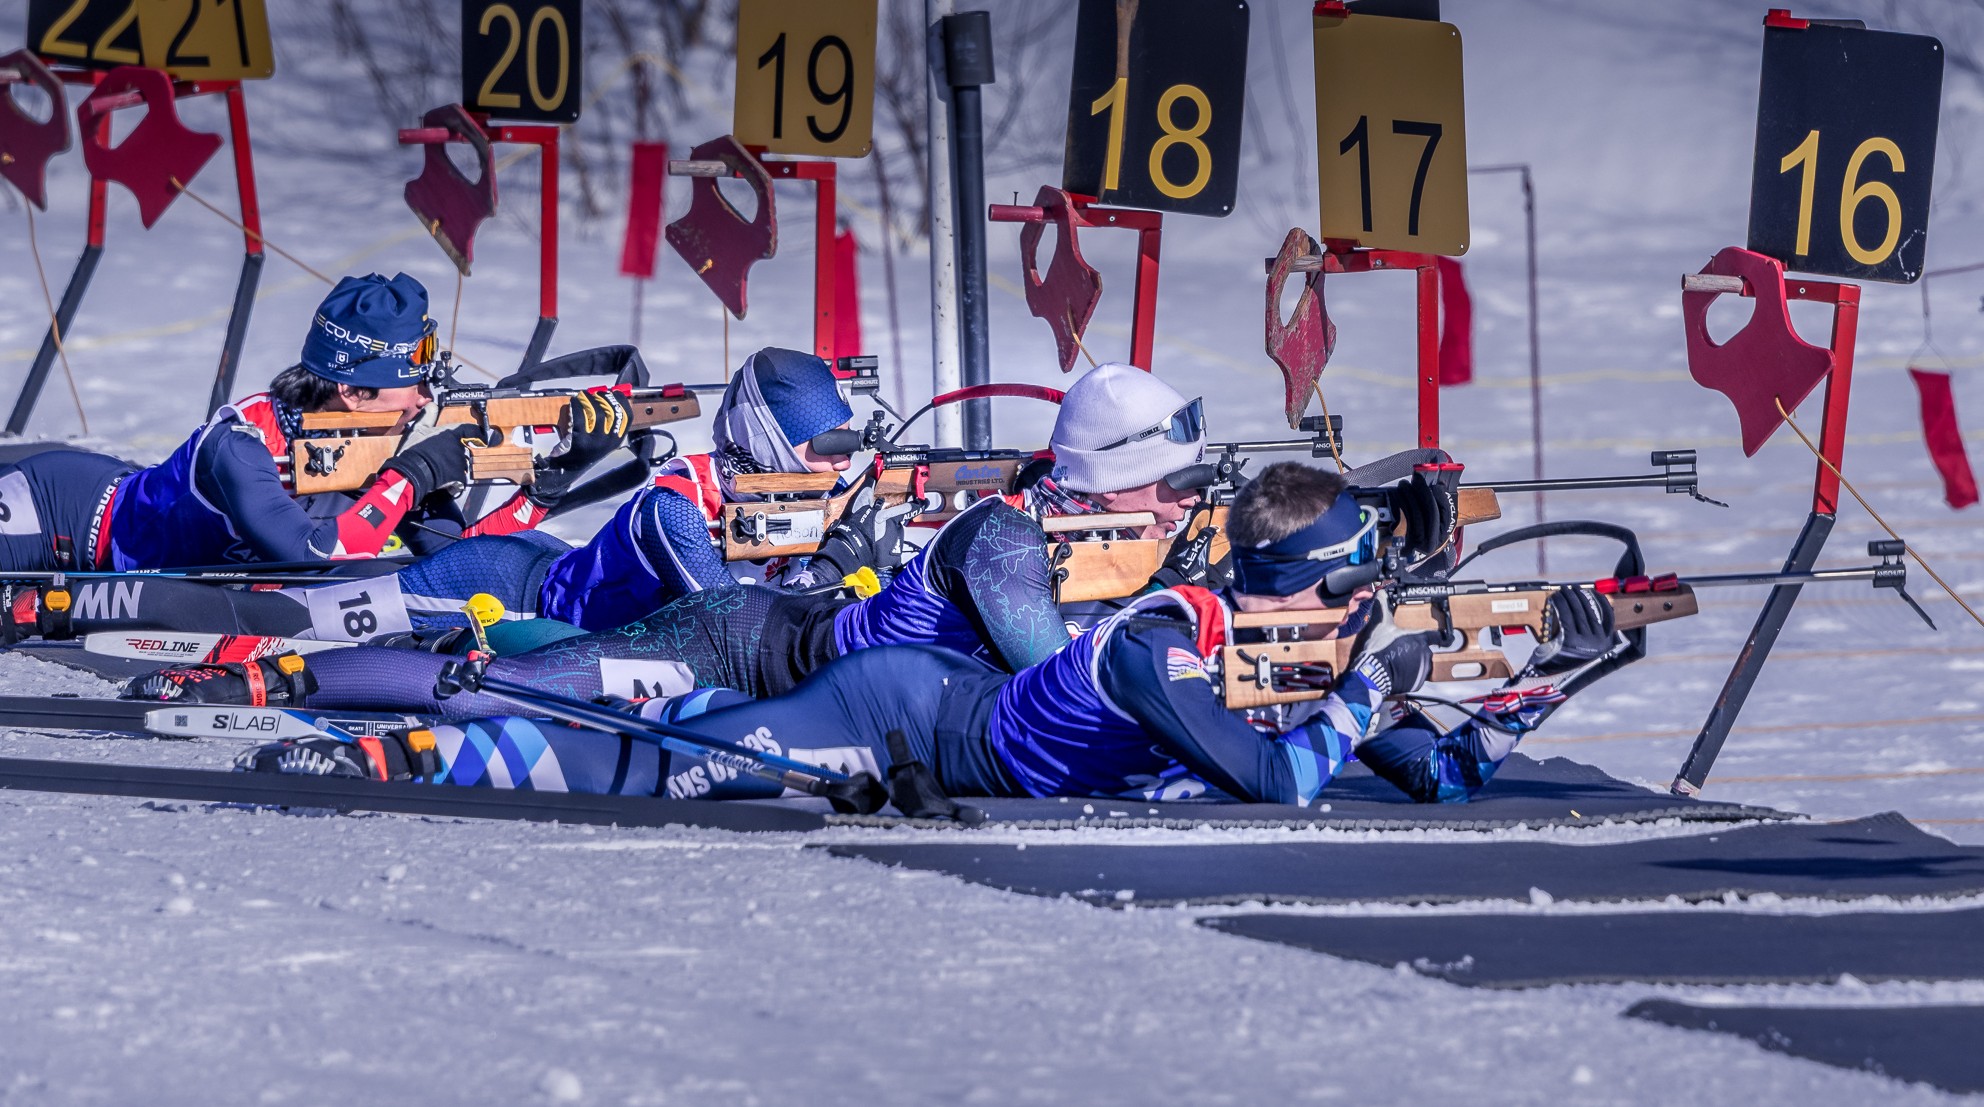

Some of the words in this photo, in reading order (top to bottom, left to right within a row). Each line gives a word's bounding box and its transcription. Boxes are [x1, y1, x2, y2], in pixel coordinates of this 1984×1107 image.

[166, 0, 251, 68] 21
[477, 4, 570, 111] 20
[757, 32, 855, 144] 19
[1091, 77, 1213, 199] 18
[1338, 115, 1443, 236] 17
[1780, 129, 1906, 265] 16
[126, 638, 201, 653] REDLINE
[339, 590, 377, 637] 18
